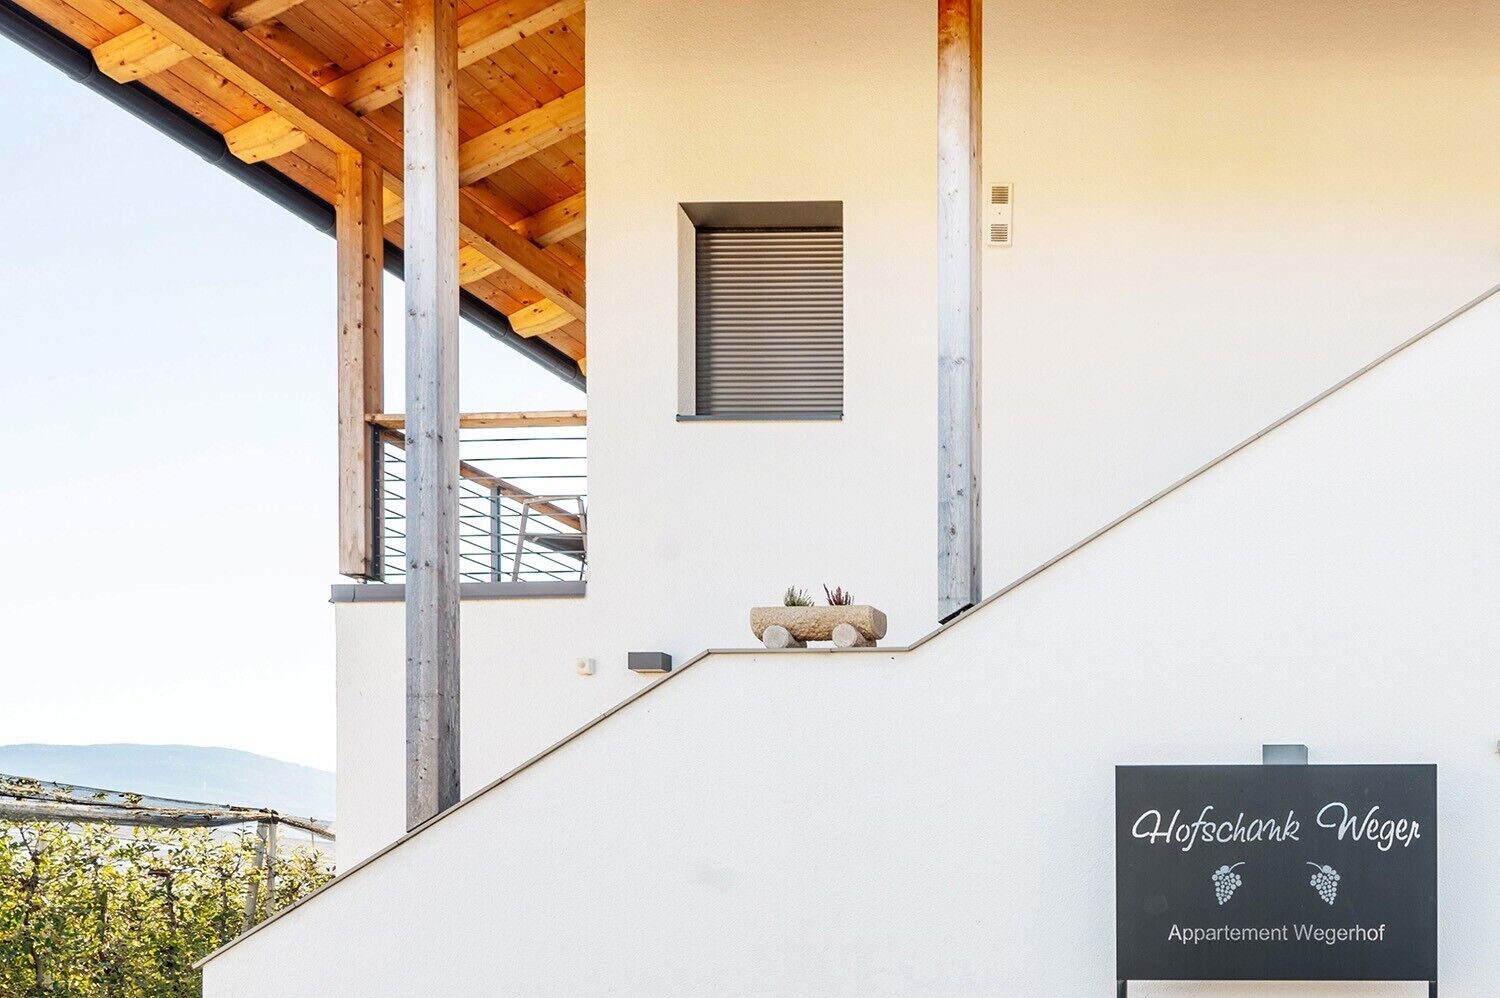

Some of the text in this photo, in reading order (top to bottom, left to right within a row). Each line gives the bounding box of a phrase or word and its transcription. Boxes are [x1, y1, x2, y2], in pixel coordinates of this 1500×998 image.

[1132, 802, 1420, 851] Hofschank Weger
[1168, 924, 1386, 945] Appartement Wegerhof
